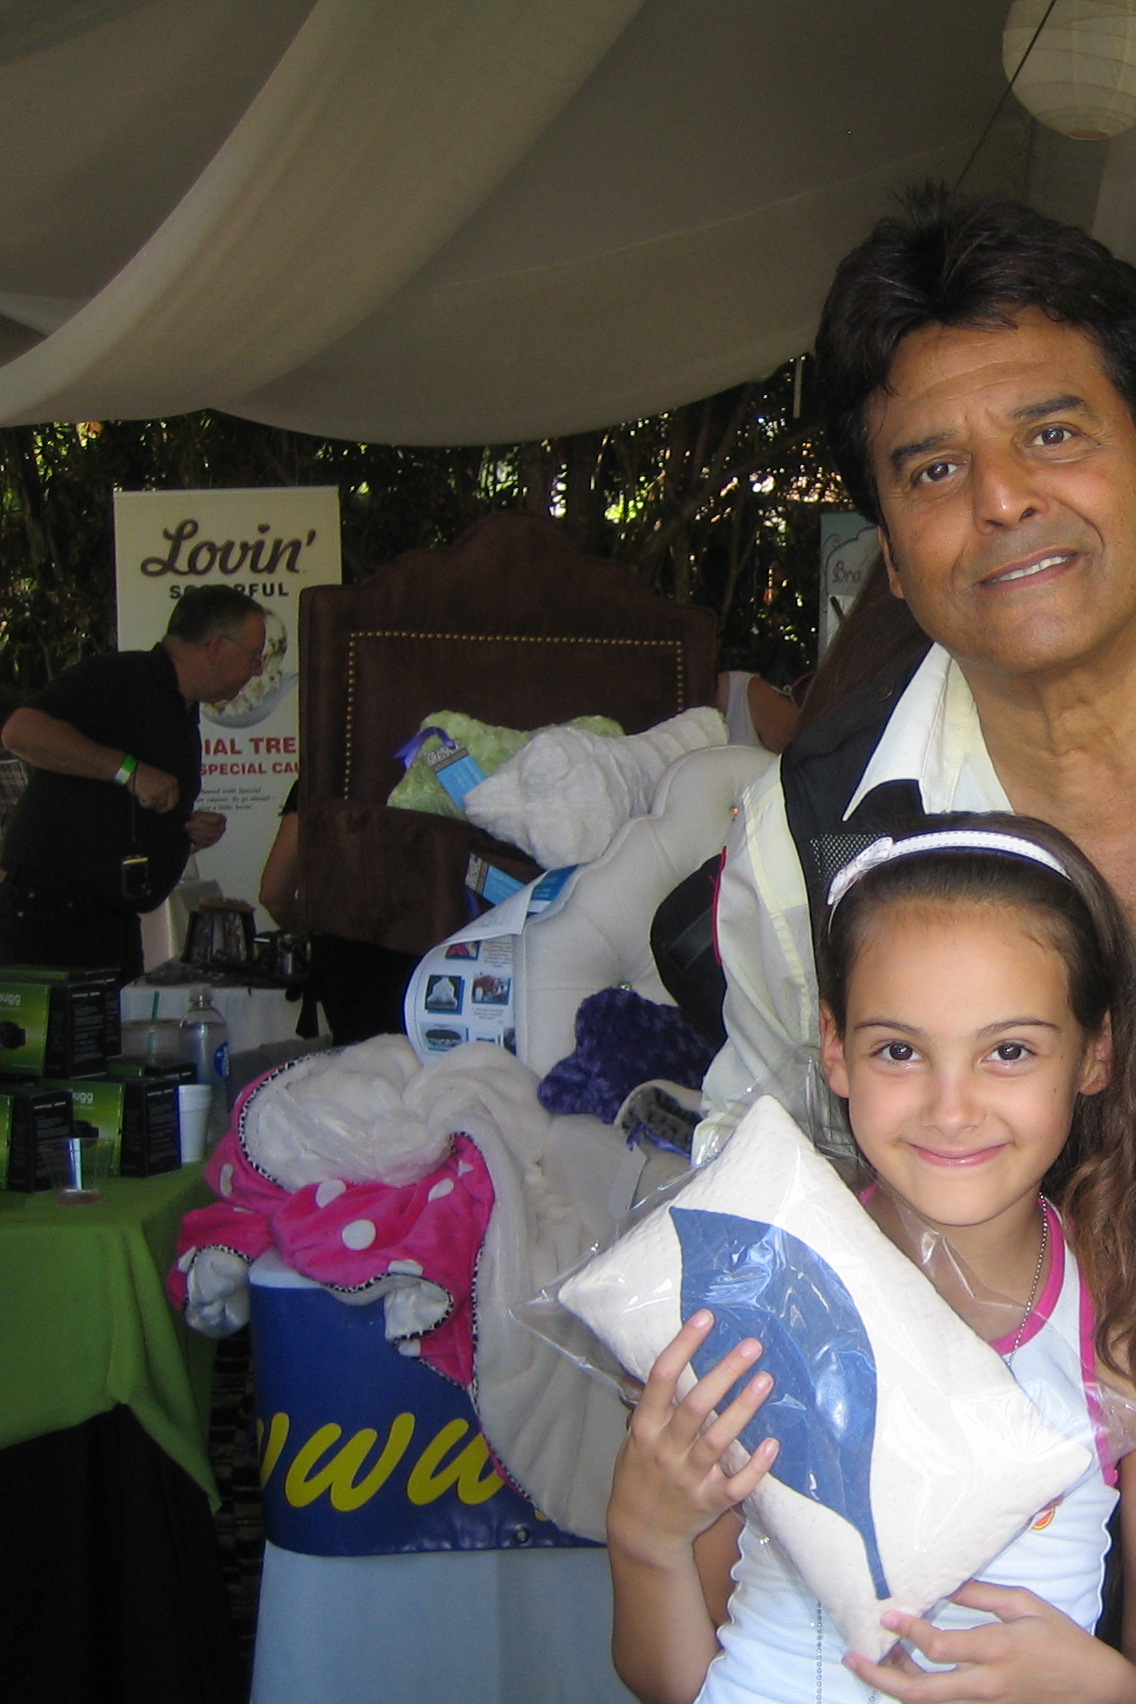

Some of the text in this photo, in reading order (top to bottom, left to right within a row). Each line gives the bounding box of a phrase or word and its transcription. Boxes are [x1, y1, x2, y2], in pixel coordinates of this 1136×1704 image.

[140, 518, 317, 577] Lovin'
[249, 736, 298, 755] TRE
[200, 762, 267, 776] SPECIAL
